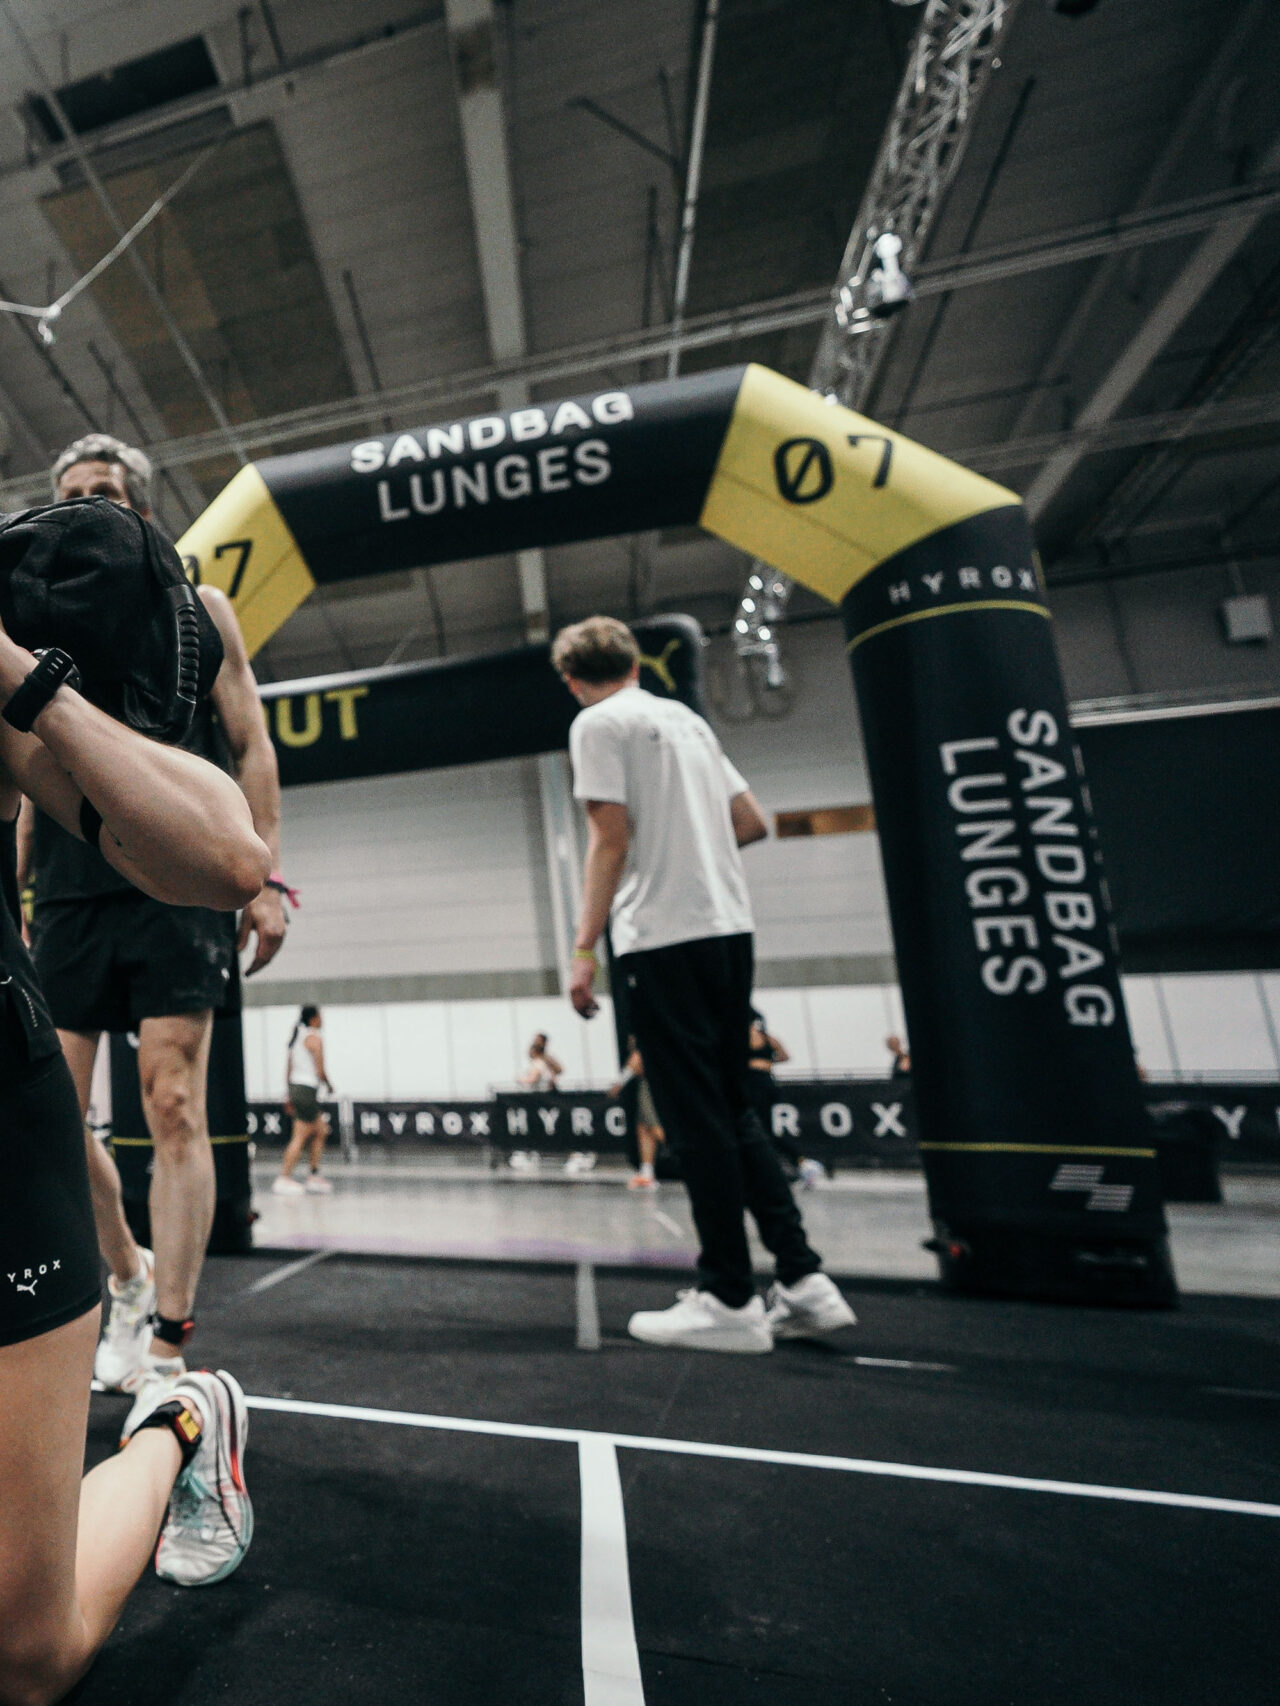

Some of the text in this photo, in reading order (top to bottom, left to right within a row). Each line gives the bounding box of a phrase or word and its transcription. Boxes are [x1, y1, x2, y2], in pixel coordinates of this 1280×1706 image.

[350, 391, 634, 473] SANDBAG
[377, 439, 612, 521] LUNGES
[888, 564, 1036, 604] HYROX
[263, 686, 369, 748] UT
[939, 736, 1046, 995] LUNGES
[1008, 709, 1115, 1026] SANDBAG
[360, 1111, 491, 1136] HYROX
[505, 1106, 627, 1137] HYRO
[771, 1102, 906, 1137] ROX
